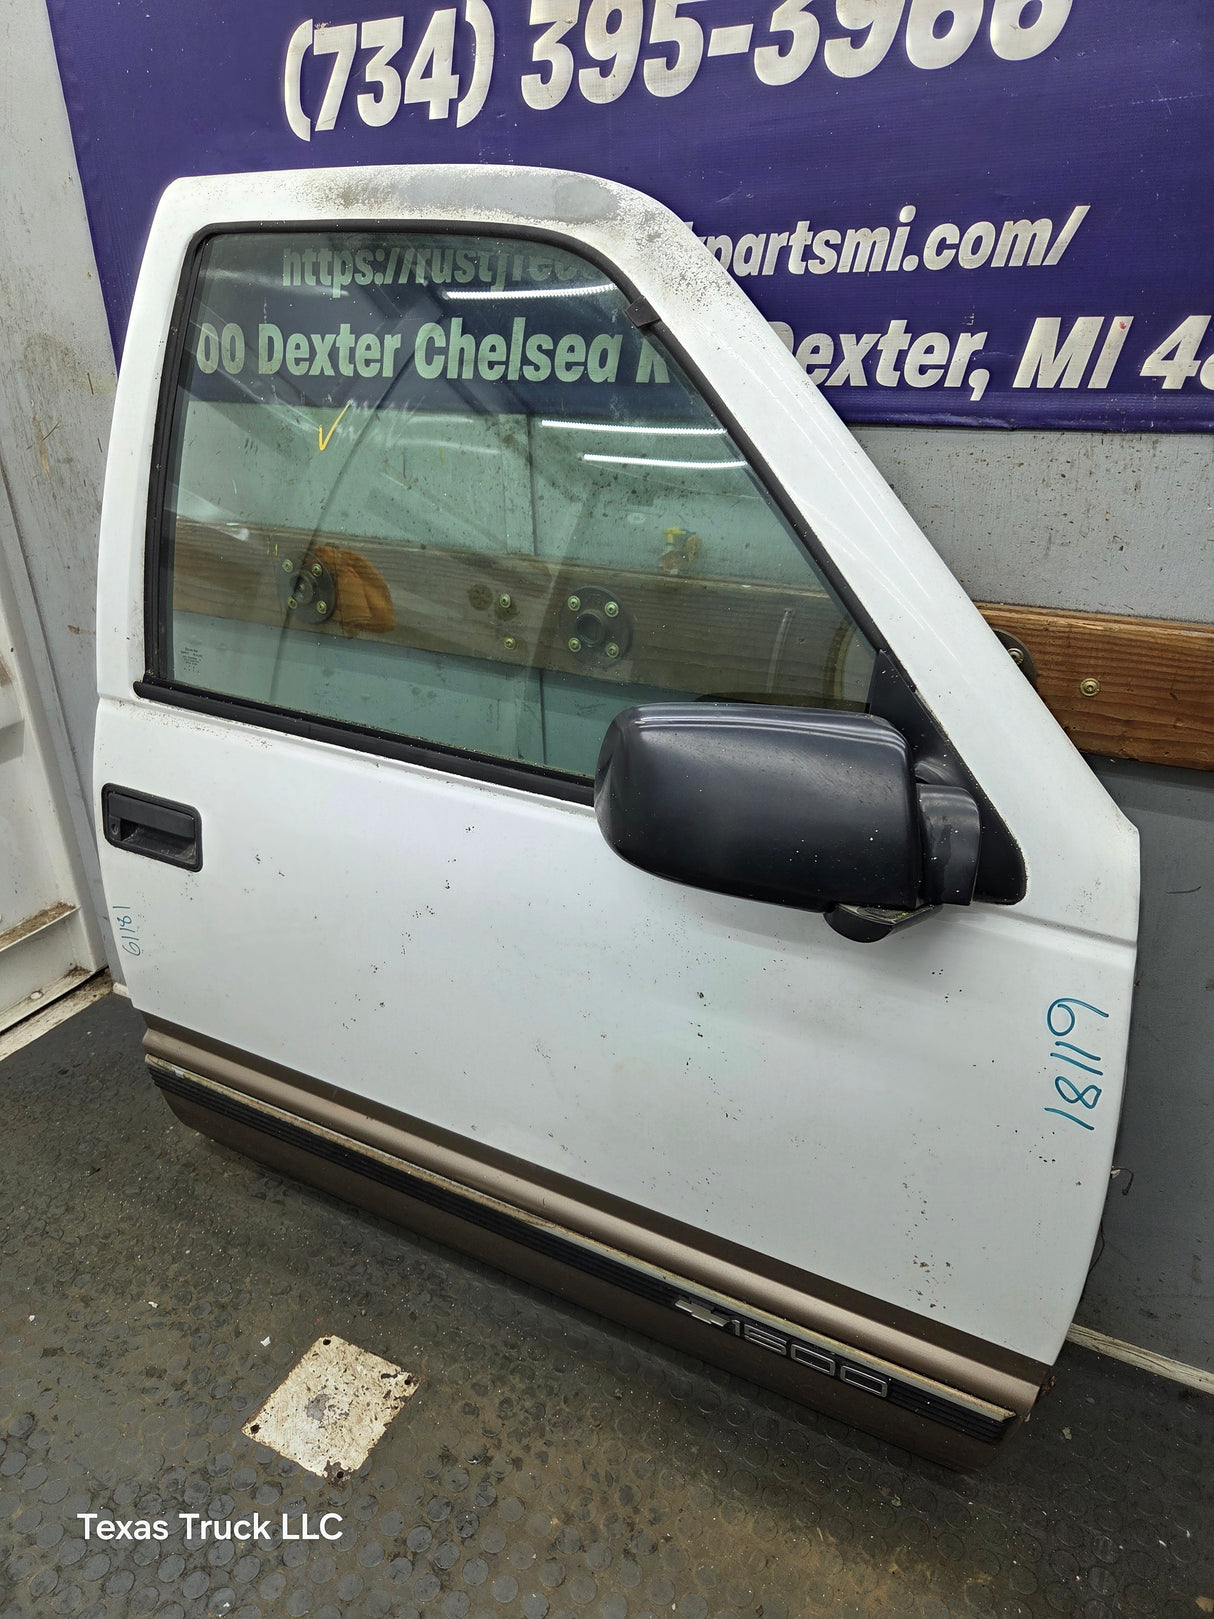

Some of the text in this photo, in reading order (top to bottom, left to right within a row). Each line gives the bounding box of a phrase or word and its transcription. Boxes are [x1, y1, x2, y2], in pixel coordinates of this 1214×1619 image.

[284, 0, 495, 142] (734)
[258, 322, 401, 378] Dexter
[414, 316, 624, 384] Chelsea
[1012, 315, 1135, 390] MI
[1139, 314, 1214, 391] 4
[731, 1318, 889, 1399] 1500
